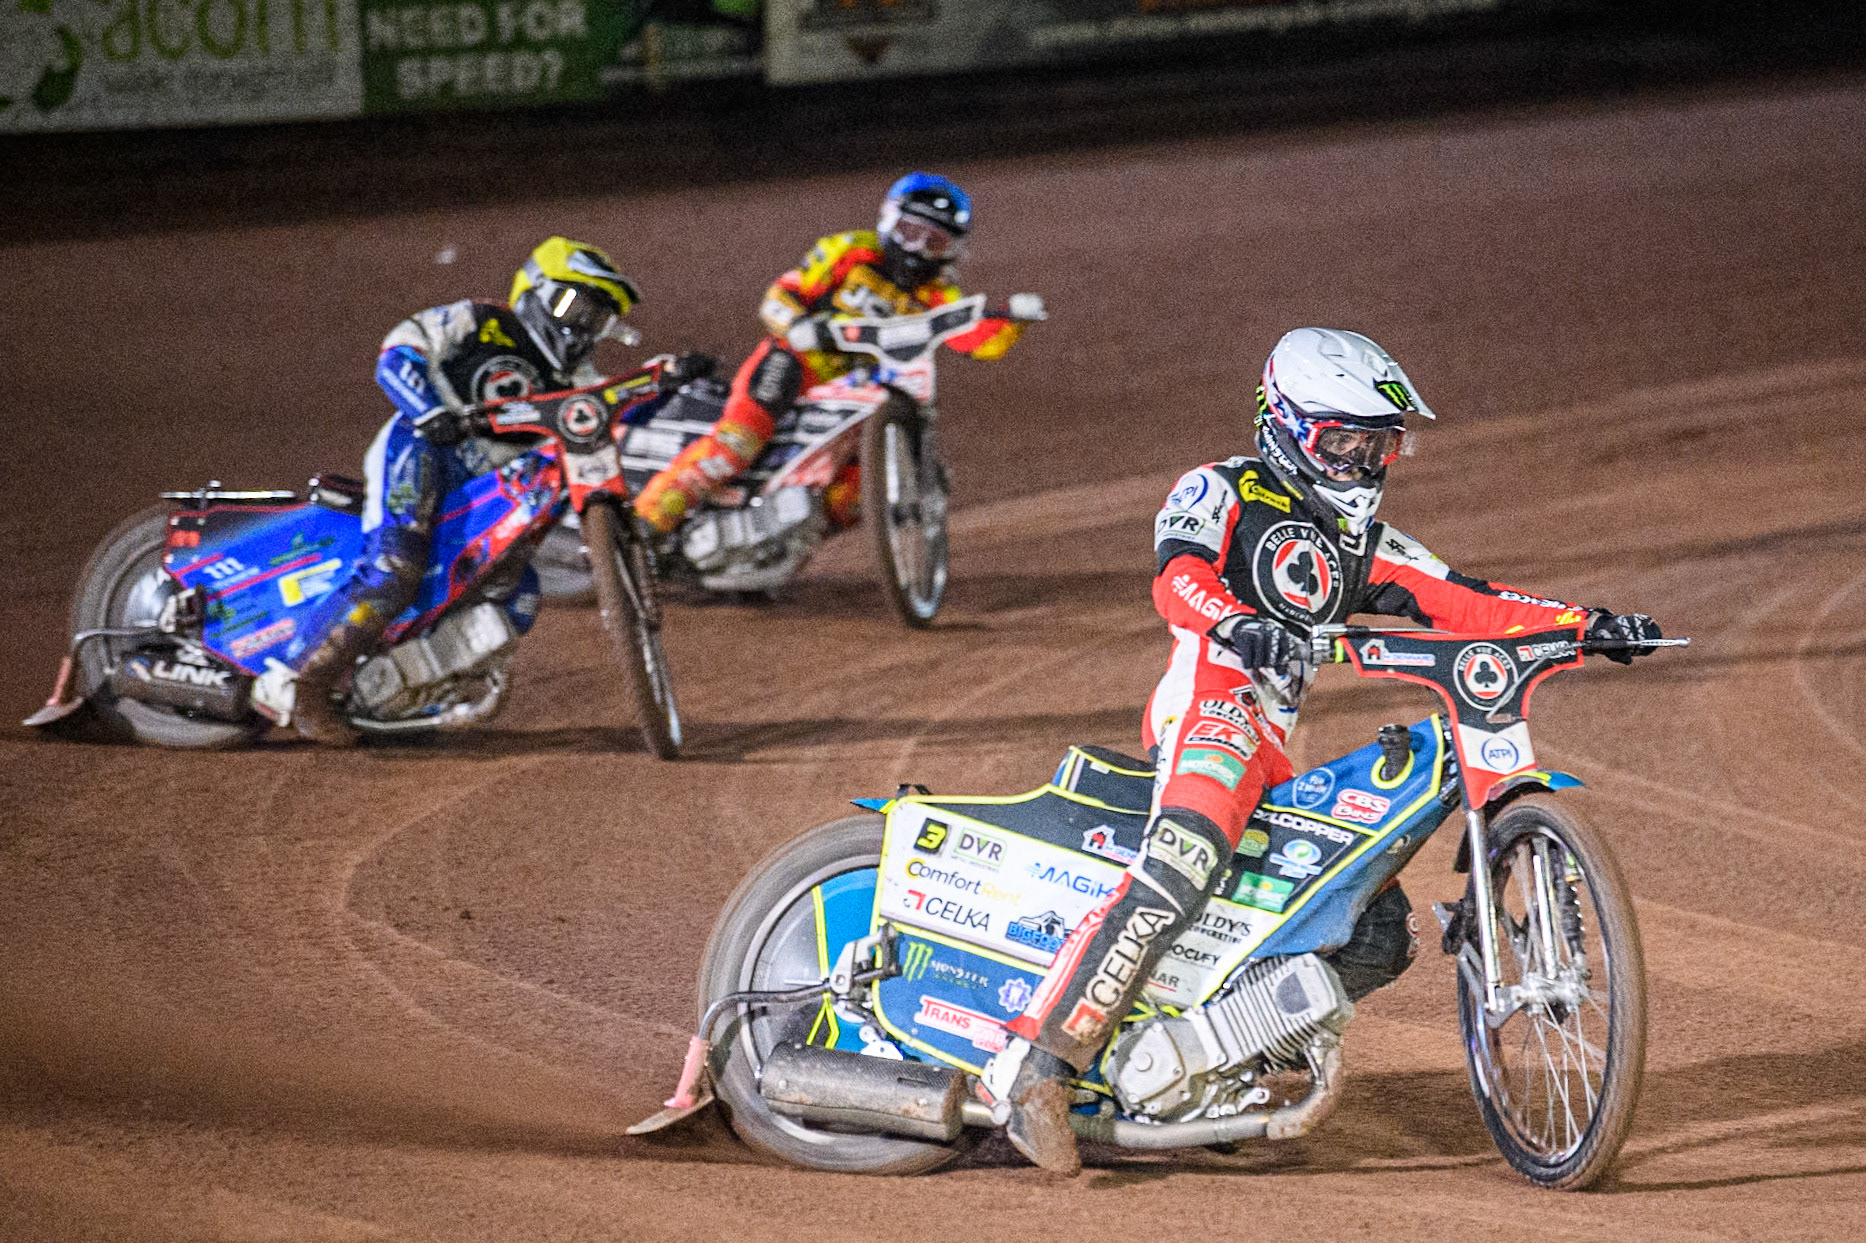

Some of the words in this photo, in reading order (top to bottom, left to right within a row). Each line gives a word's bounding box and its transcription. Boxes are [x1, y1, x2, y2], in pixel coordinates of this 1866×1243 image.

[365, 5, 487, 48] NEED
[501, 1, 588, 42] FOR
[399, 50, 565, 97] SPEED?
[1265, 527, 1296, 551] BELLE
[916, 823, 948, 850] 3
[958, 833, 1003, 861] DVR
[1158, 827, 1210, 874] DVR
[925, 897, 991, 932] CELKA
[1200, 913, 1254, 937] LDY'S
[931, 959, 989, 988] MONSTER
[1090, 911, 1170, 1008] CELKA
[923, 998, 972, 1030] TRANS
